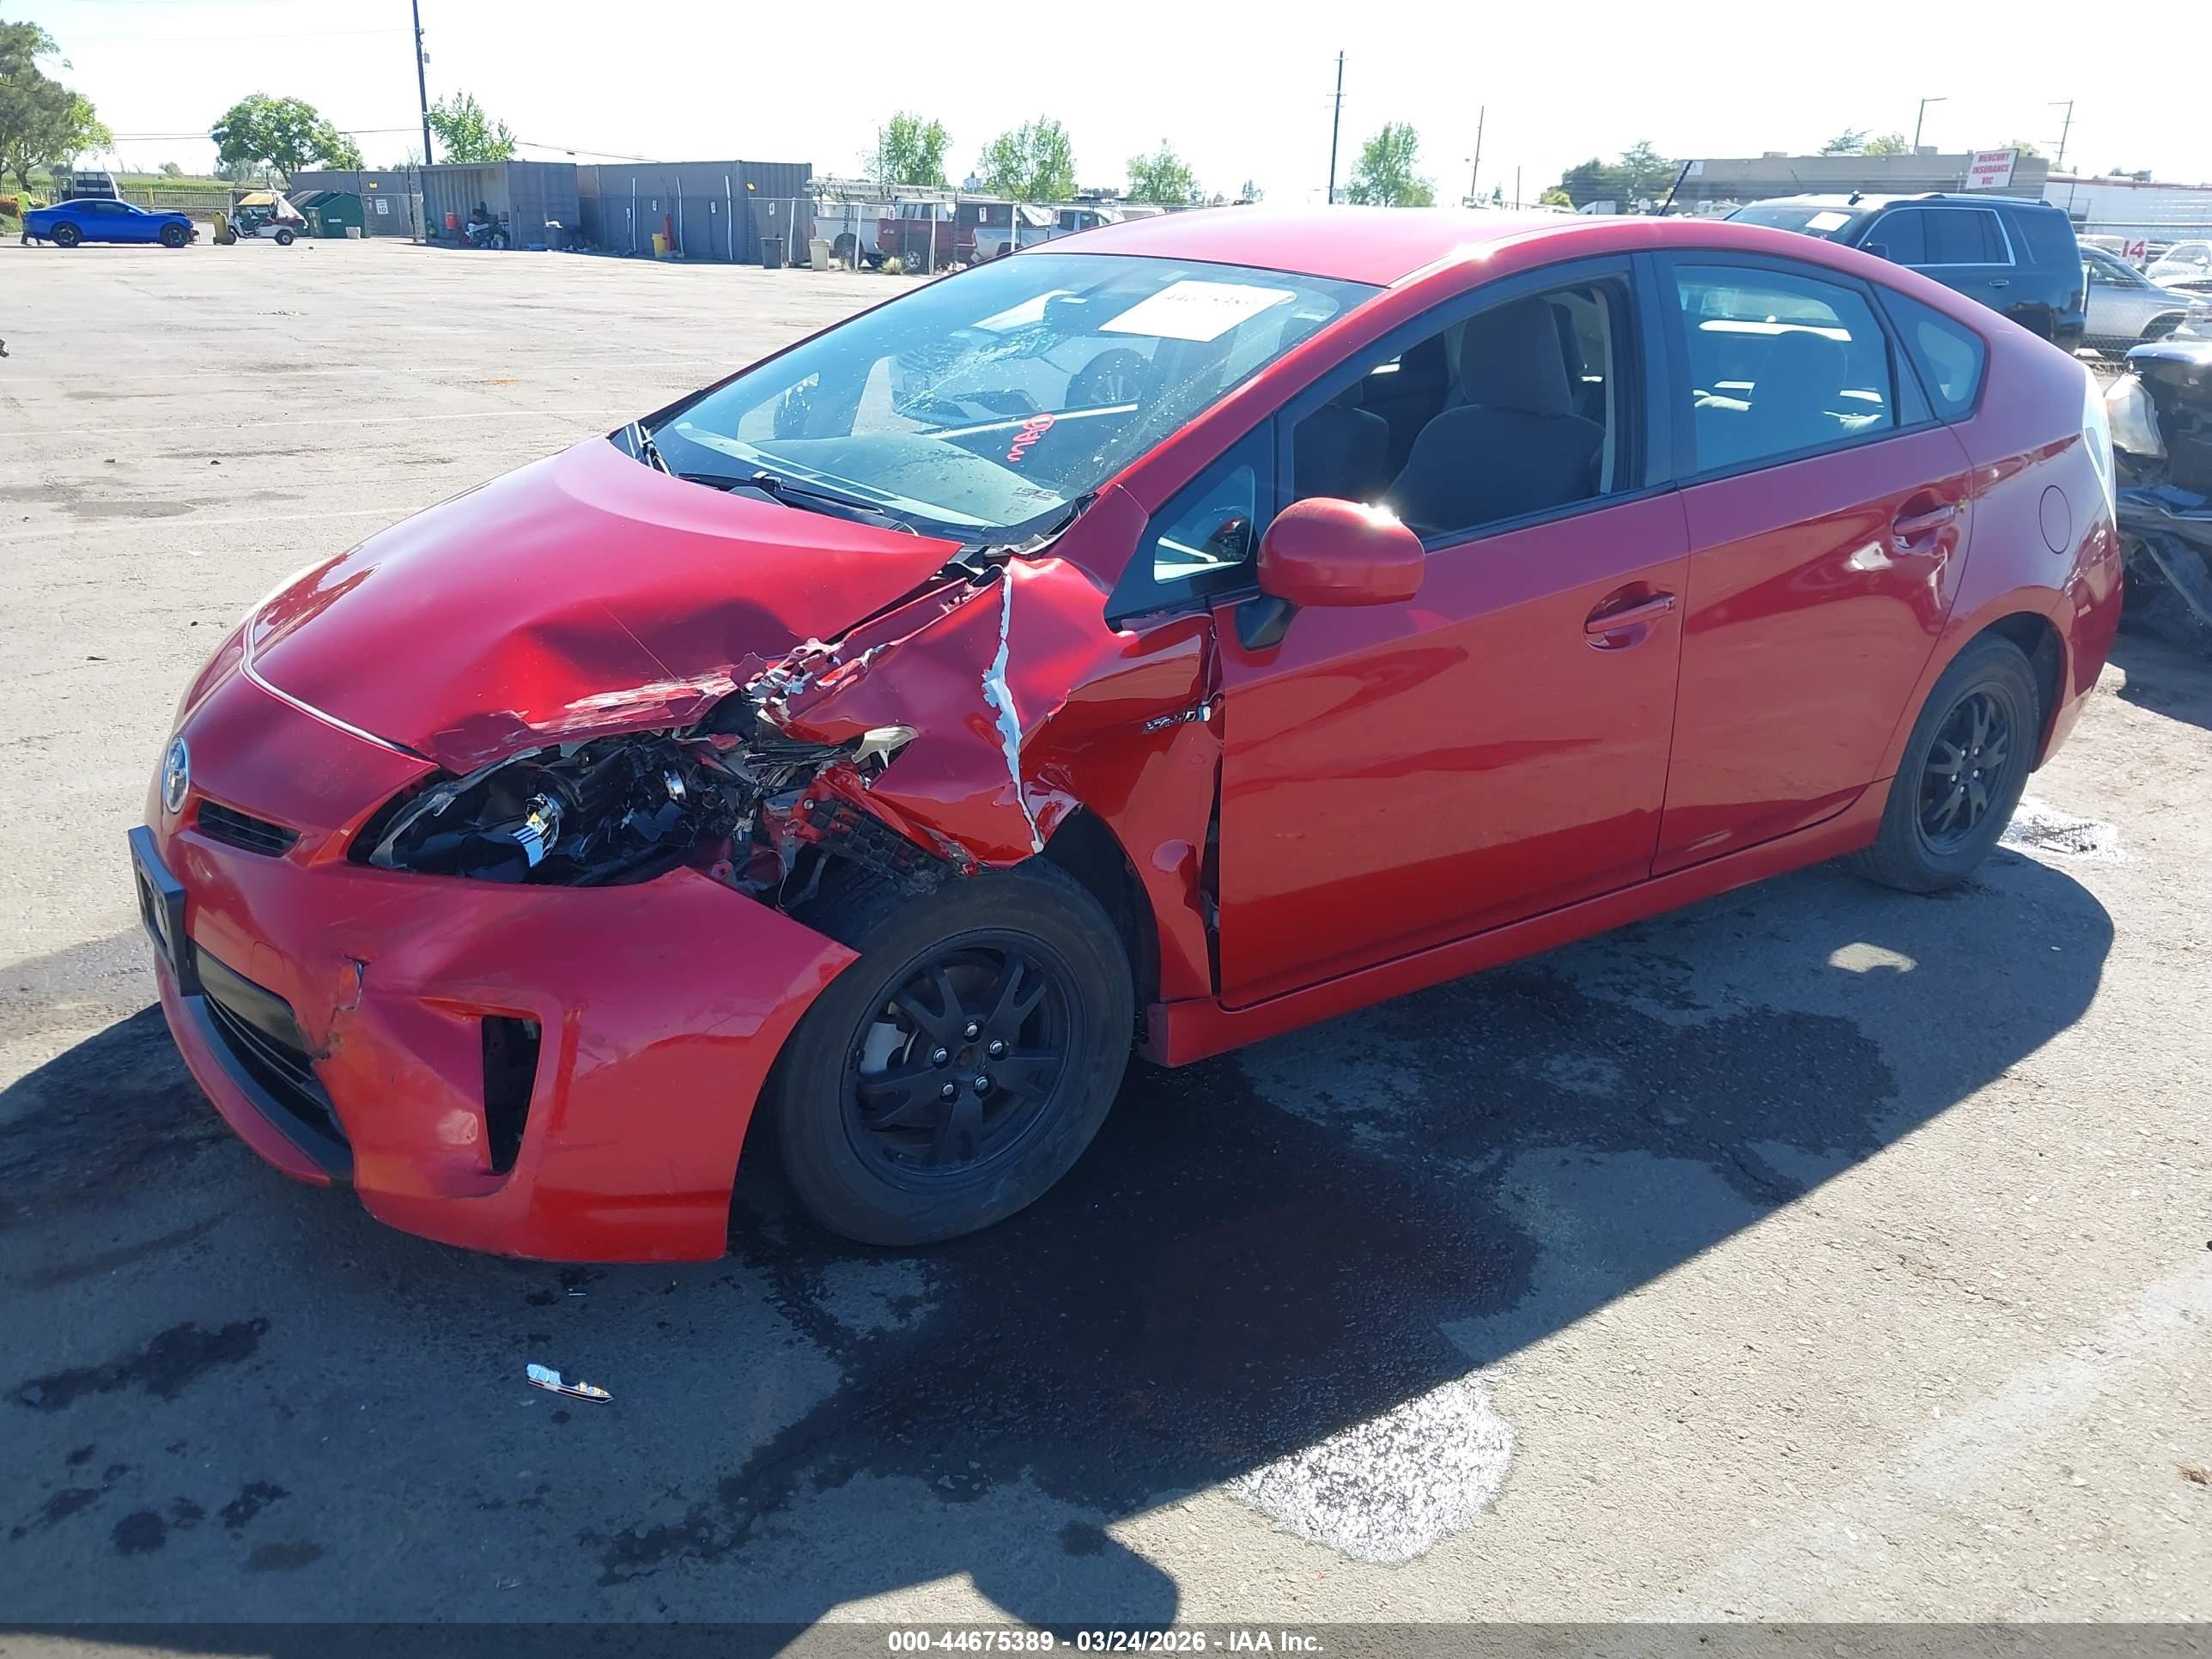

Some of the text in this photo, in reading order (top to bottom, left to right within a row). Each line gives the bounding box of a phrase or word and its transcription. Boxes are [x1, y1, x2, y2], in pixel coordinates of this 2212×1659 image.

[1978, 153, 2010, 162] MERCURY
[1972, 164, 2010, 174] INSURANCE
[1981, 176, 1994, 185] VIC
[2122, 240, 2146, 258] 14
